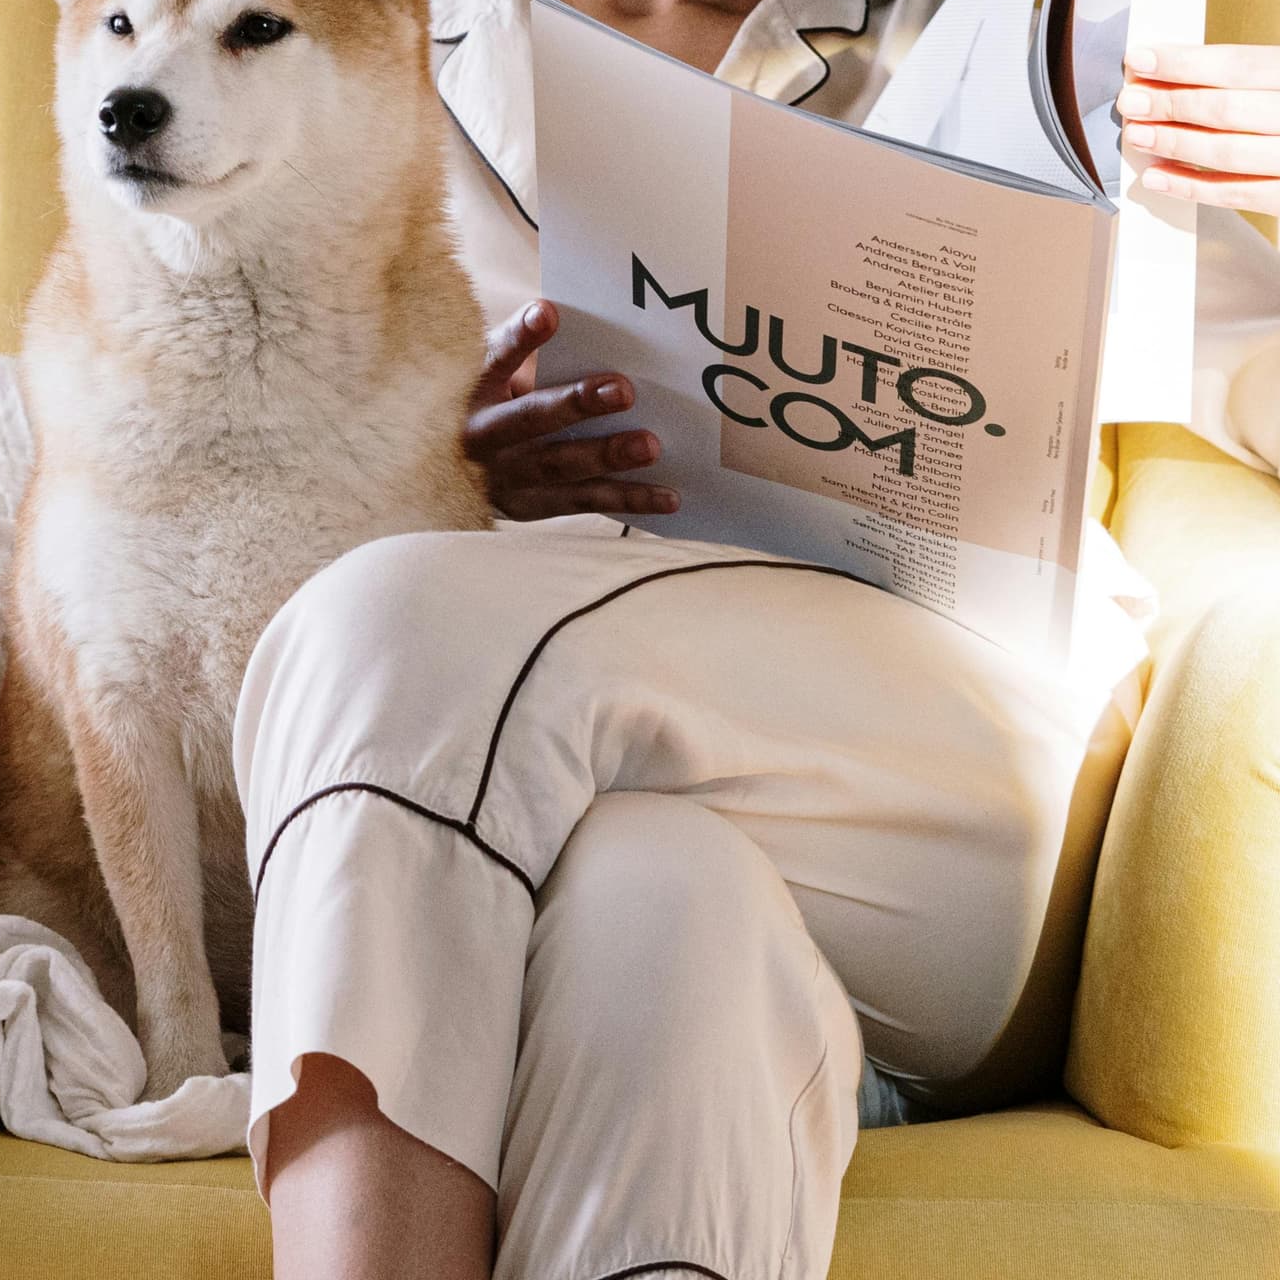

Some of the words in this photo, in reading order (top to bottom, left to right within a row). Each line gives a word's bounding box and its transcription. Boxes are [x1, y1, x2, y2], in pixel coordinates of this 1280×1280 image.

[855, 242, 908, 265] Andreas
[911, 259, 975, 284] Bergsaker
[871, 235, 937, 262] Anderssen
[940, 257, 949, 265] &
[953, 260, 976, 273] Voll
[862, 257, 916, 279] Andreas
[919, 273, 975, 296] Engesvik
[898, 280, 939, 298] Atelier
[830, 280, 880, 305] Broberg
[883, 299, 892, 307] &
[895, 301, 972, 330] Ridderstråle
[865, 280, 924, 305] Benjamin
[928, 300, 973, 318] Hubert
[827, 303, 882, 327] Claesson
[886, 322, 935, 343] Koivisto
[938, 338, 970, 352] Rune
[890, 312, 932, 330] Cecilie
[936, 326, 971, 341] Manz
[874, 329, 910, 347] David
[914, 342, 970, 363] Geckeler
[883, 344, 924, 362] Dimitri
[701, 363, 916, 478] COM
[851, 402, 889, 419] Johan
[893, 414, 916, 426] van
[920, 421, 964, 439] Hengel
[864, 417, 900, 433] Julien
[923, 433, 964, 450] Smedt
[854, 445, 900, 464] Mattias
[821, 476, 848, 489] Sam
[851, 485, 886, 501] Hecht
[890, 497, 899, 506] &
[902, 501, 925, 513] Kim
[927, 509, 959, 522] Colin
[871, 483, 918, 501] Normal
[920, 495, 960, 512] Studio
[872, 472, 902, 487] Mika
[906, 481, 960, 502] Tolvanen
[922, 475, 960, 491] Studio
[841, 490, 878, 508] Simon
[881, 504, 902, 517] Key
[905, 512, 958, 532] Bertman
[878, 511, 922, 532] Staffan
[925, 527, 958, 542] Holm
[844, 538, 890, 561] Thomas
[859, 536, 905, 560] Thomas
[865, 514, 903, 534] Studio
[905, 531, 957, 552] Kaksikko
[888, 533, 915, 547] Rose
[919, 544, 957, 561] Studio
[919, 552, 956, 570] Studio
